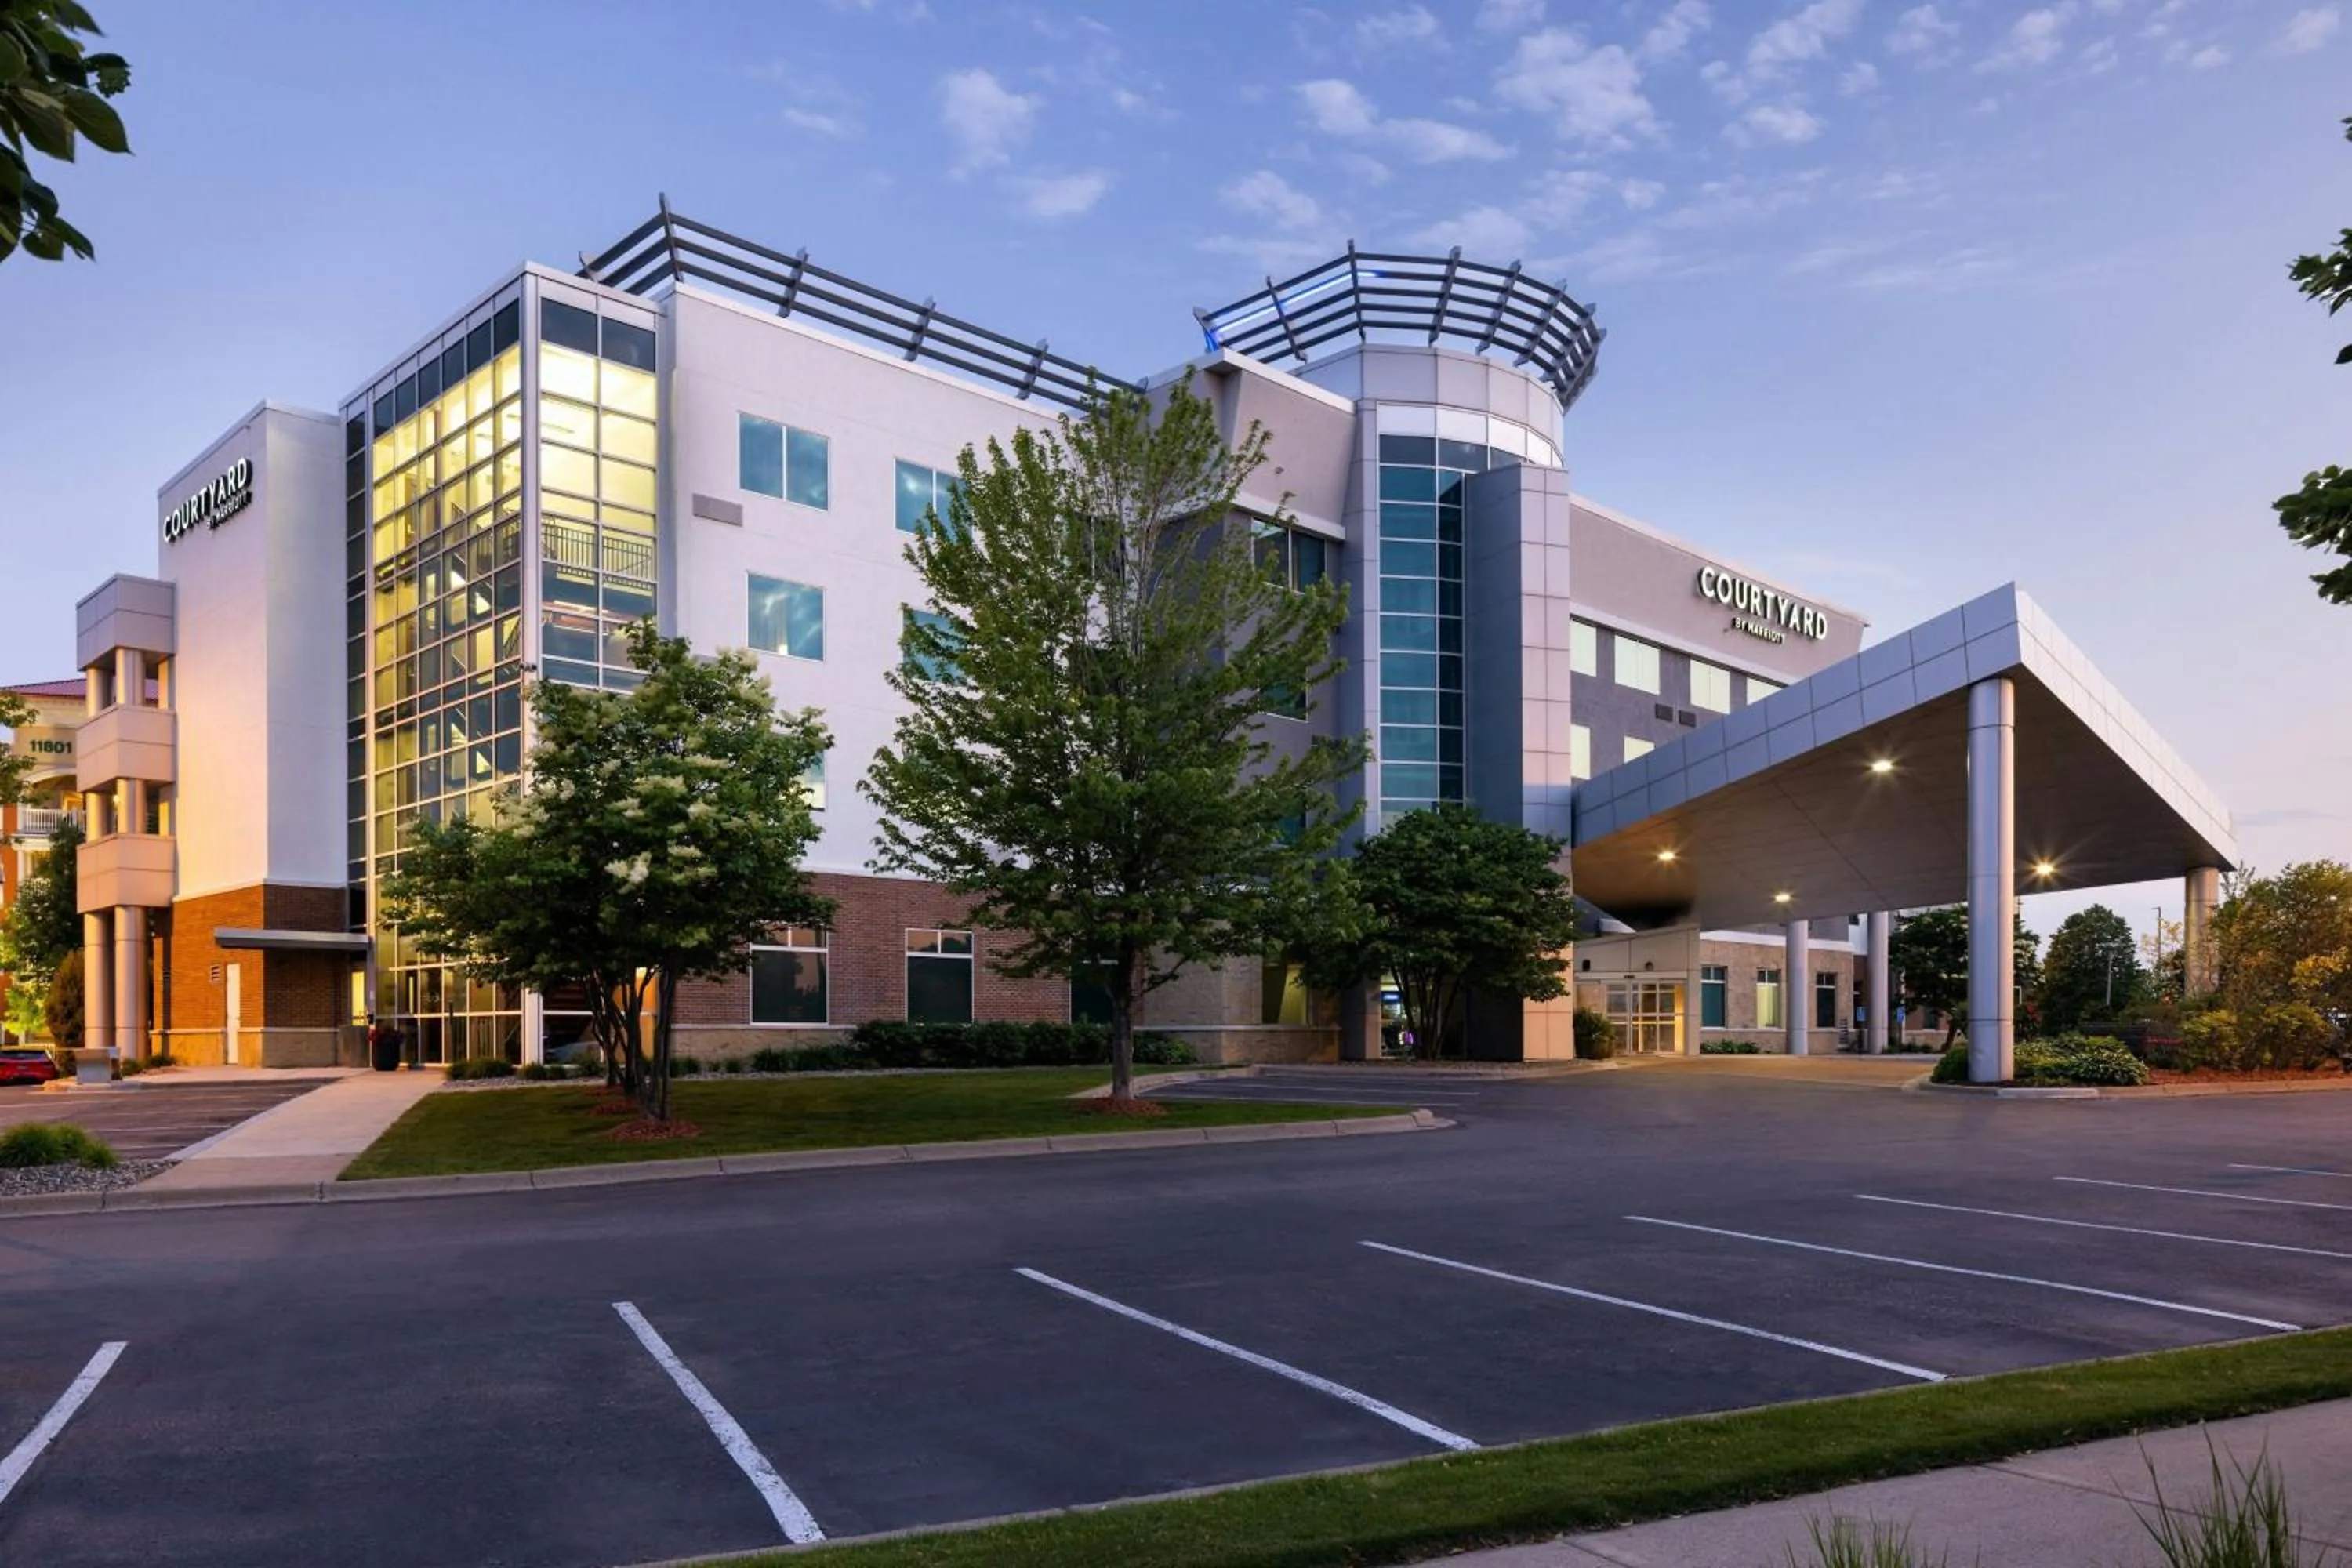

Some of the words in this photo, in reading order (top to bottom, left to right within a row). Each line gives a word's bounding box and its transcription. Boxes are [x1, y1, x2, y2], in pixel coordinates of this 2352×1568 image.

[162, 457, 248, 543] COURTYARD
[1700, 566, 1828, 641] COURTYARD
[1736, 617, 1748, 630] BY
[30, 739, 72, 753] 11801
